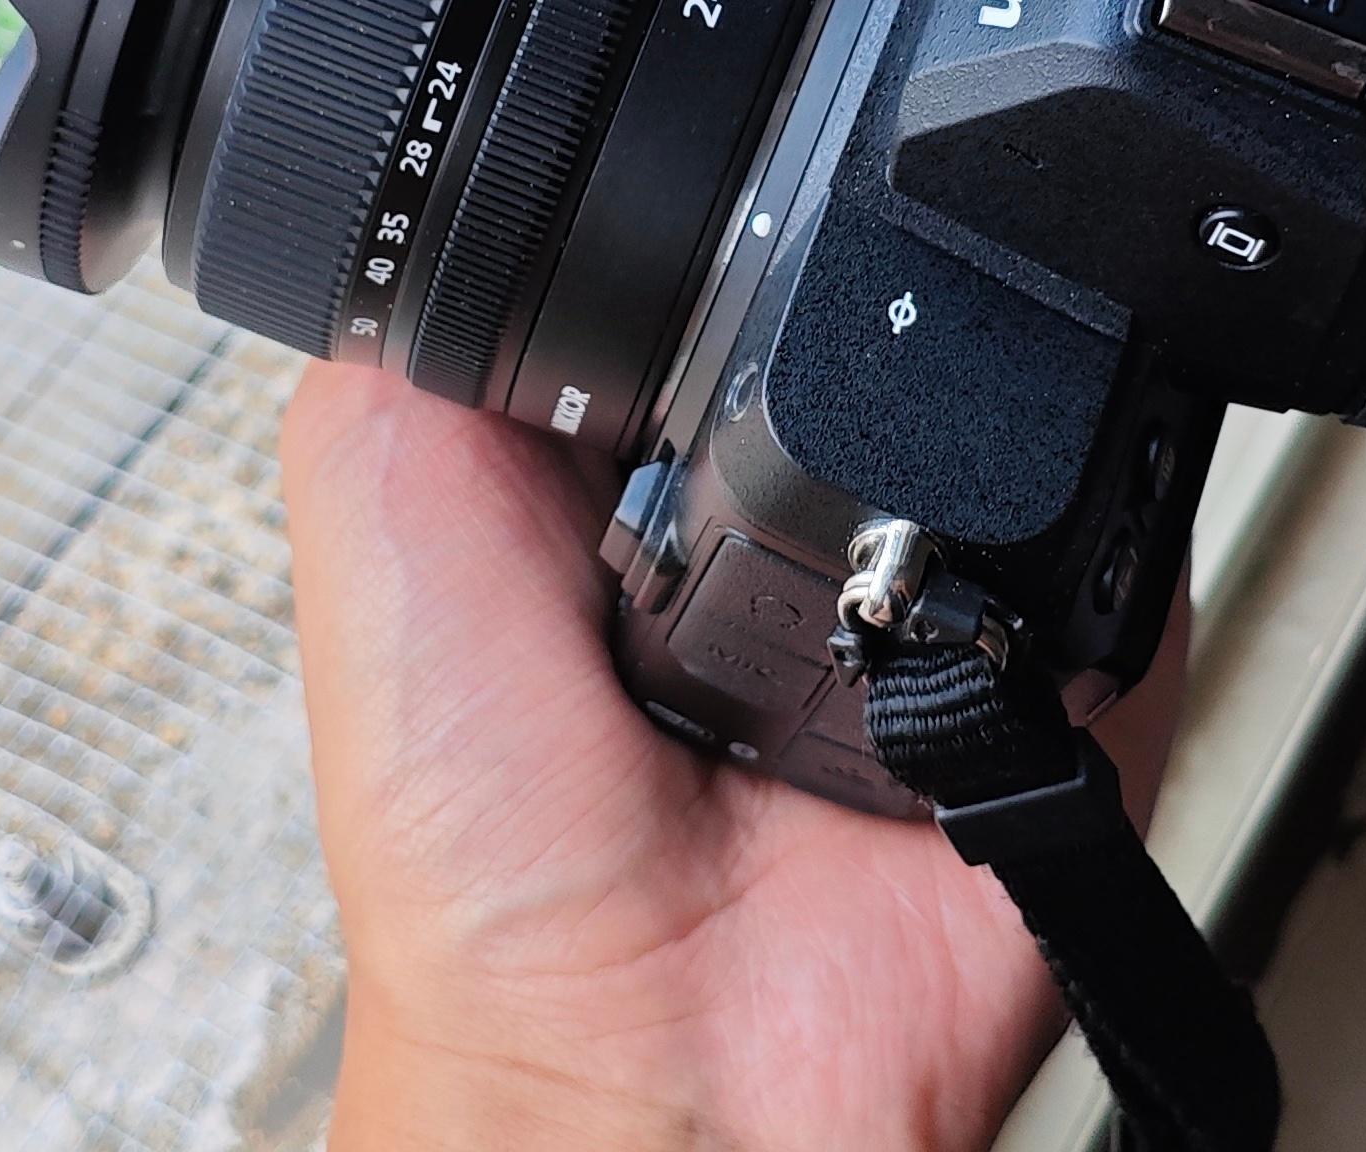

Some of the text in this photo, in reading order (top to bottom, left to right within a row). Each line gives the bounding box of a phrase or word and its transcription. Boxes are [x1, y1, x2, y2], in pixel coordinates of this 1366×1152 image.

[350, 60, 463, 337] 50 40 35 28 24
